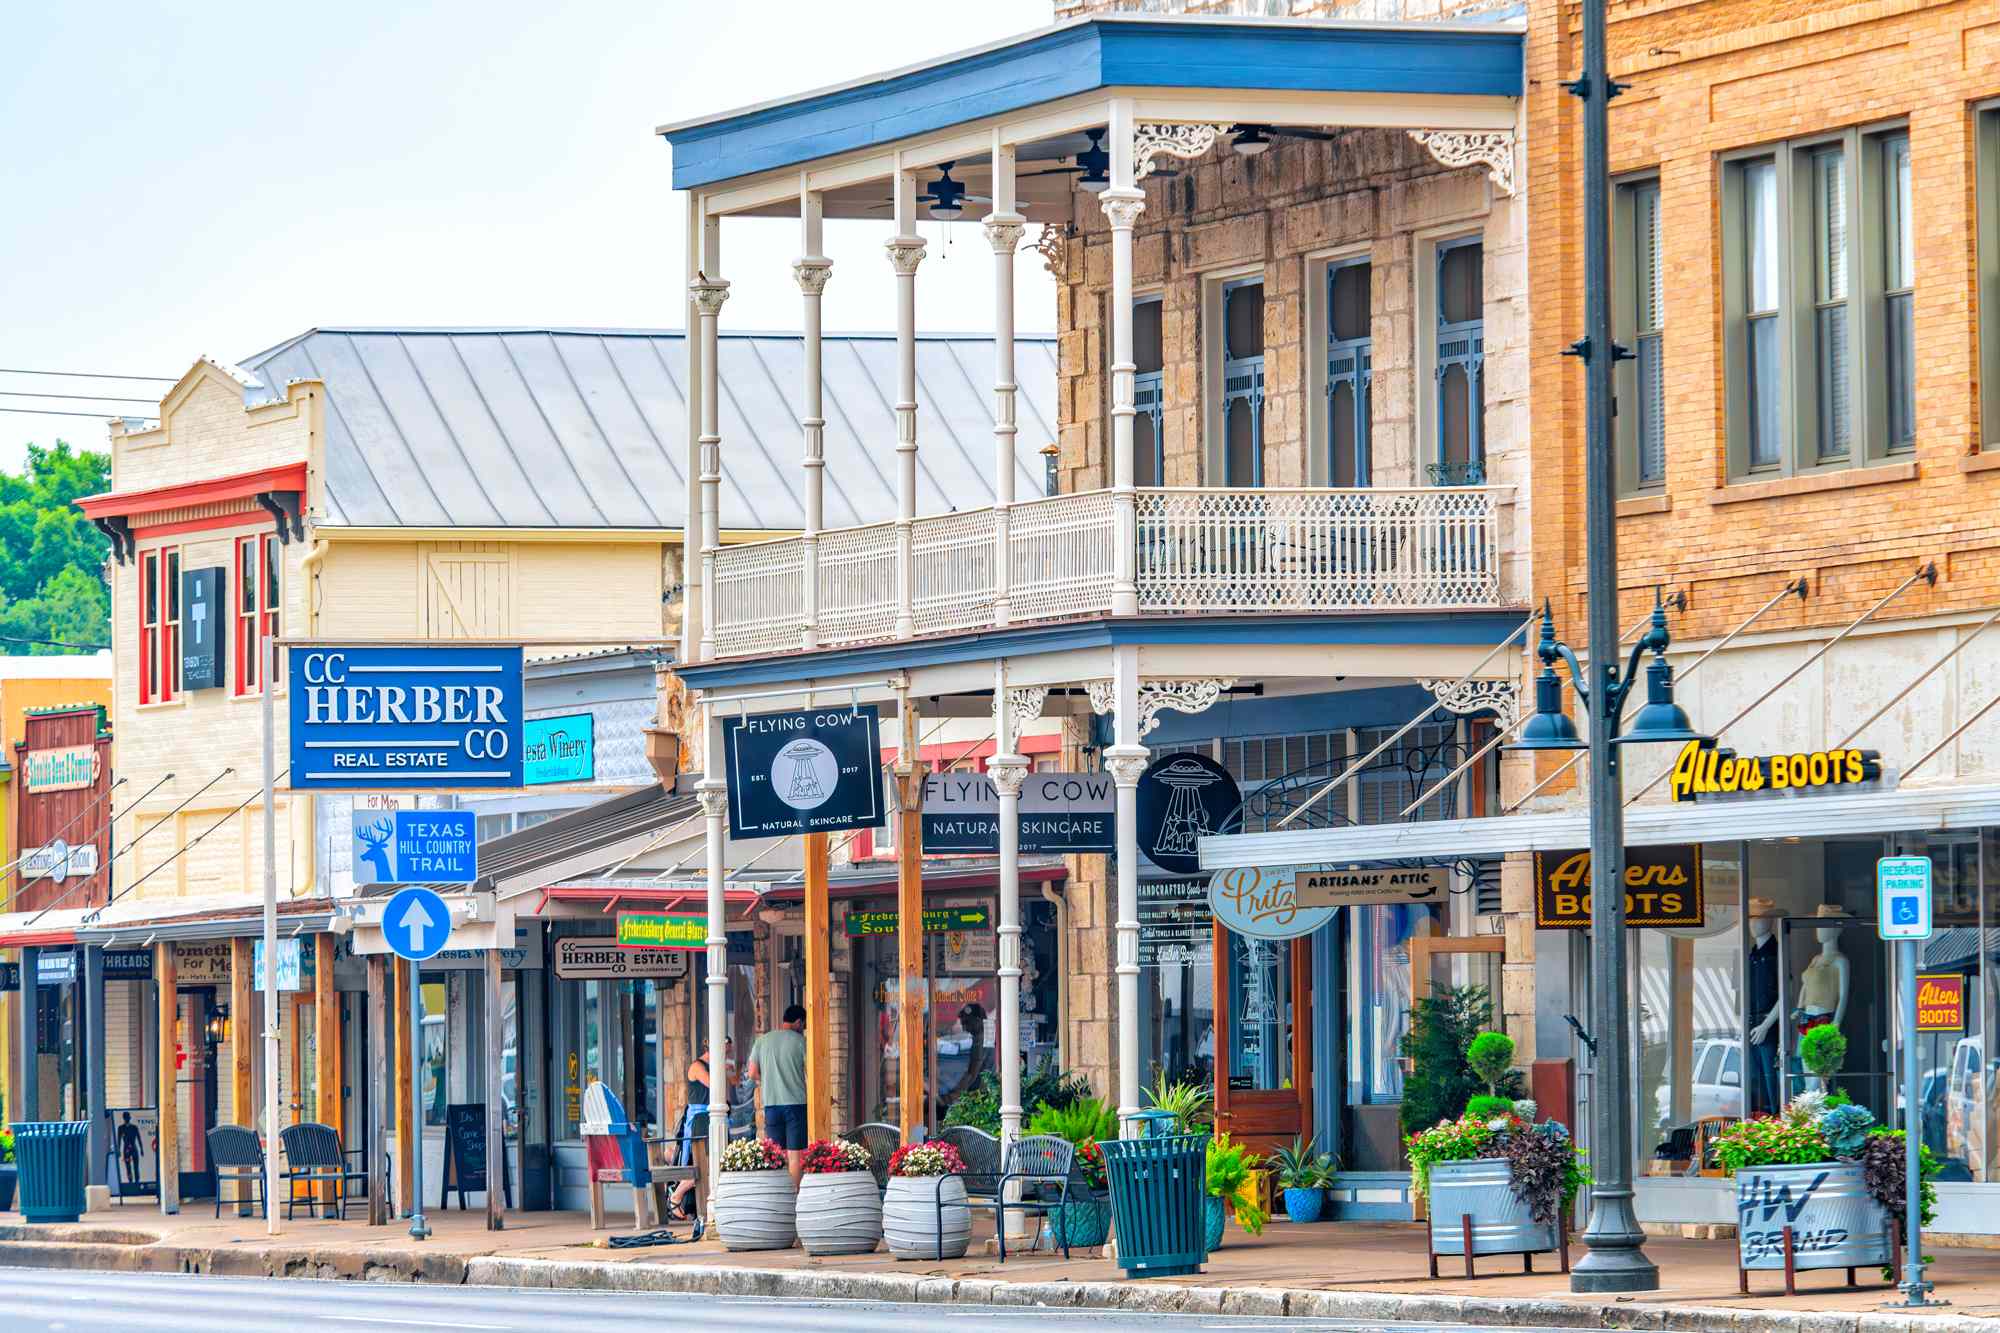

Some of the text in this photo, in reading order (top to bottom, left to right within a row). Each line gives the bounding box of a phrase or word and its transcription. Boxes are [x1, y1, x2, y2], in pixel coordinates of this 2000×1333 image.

[304, 653, 345, 683] CC
[304, 686, 508, 724] HERBER
[749, 712, 853, 734] FLYING COW
[464, 729, 509, 759] CO
[333, 752, 448, 767] REAL ESTATE
[526, 730, 587, 776] esta Winery
[751, 766, 859, 782] EST. 2017
[1670, 740, 1864, 802] Allens BOOTS
[1041, 780, 1109, 801] COW
[762, 814, 853, 831] NATURAL SKINCARE
[933, 820, 1104, 835] NATURA SKINCARE
[407, 823, 466, 838] TEXAS
[400, 840, 472, 855] HILL COUNTRY
[409, 857, 464, 872] TRAIL
[1548, 851, 1688, 893] Aens
[1882, 864, 1926, 876] RESERVED
[1307, 873, 1430, 889] ARTISANS' ATTIC
[1886, 879, 1924, 889] PARKING
[1137, 884, 1186, 897] HANDCRAFTED
[861, 922, 949, 934] Souirs
[561, 942, 576, 952] CC
[562, 951, 626, 964] HERBER
[633, 954, 679, 965] ESTATE
[183, 958, 232, 973] For Me
[611, 964, 627, 974] CO
[1917, 981, 1960, 1009] Allens
[1919, 1009, 1958, 1024] BOOTS
